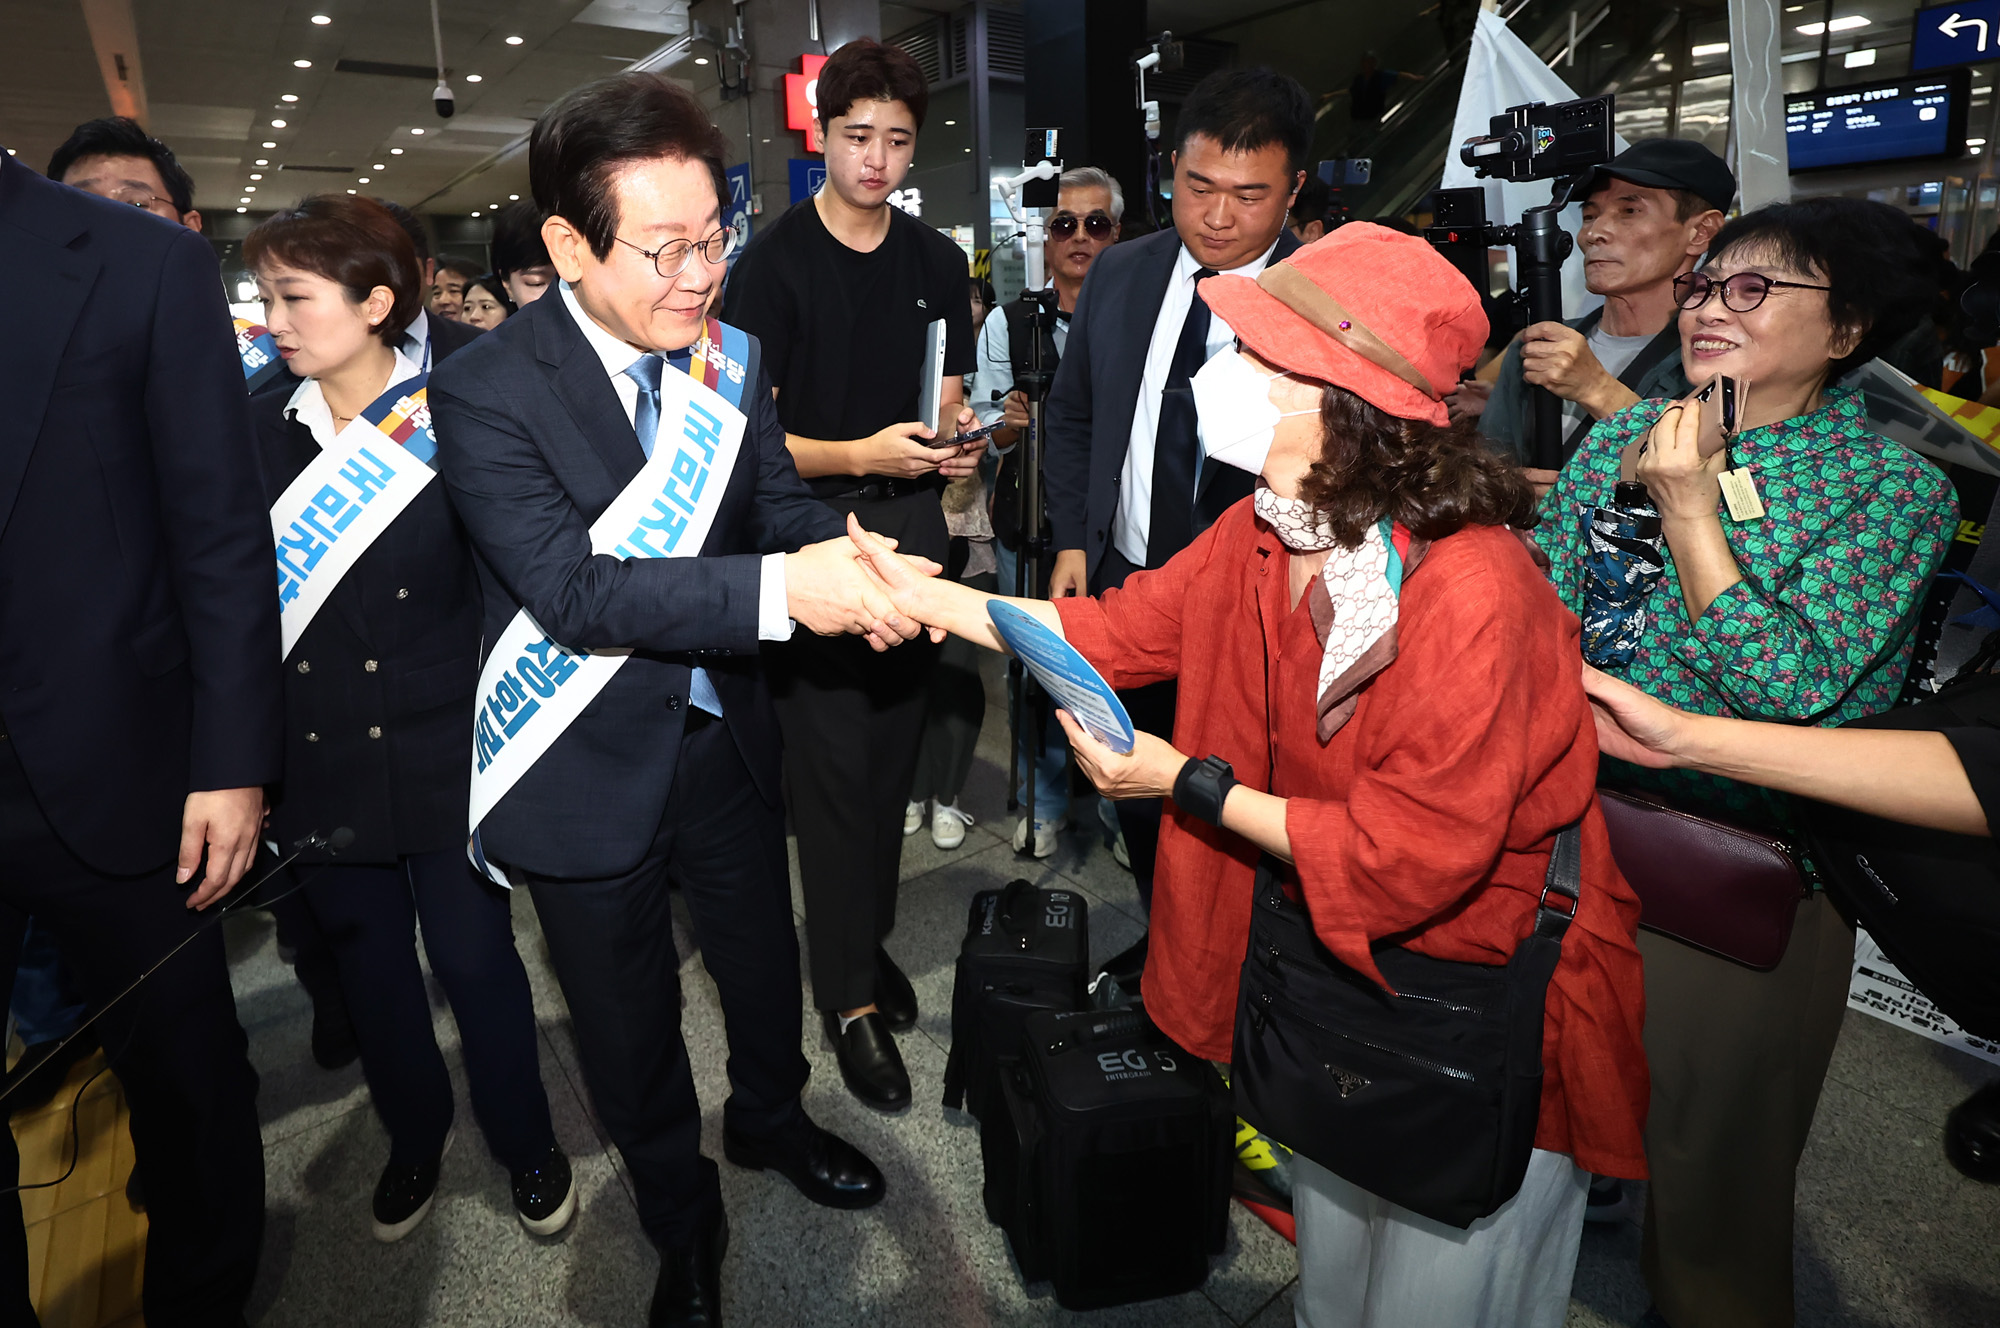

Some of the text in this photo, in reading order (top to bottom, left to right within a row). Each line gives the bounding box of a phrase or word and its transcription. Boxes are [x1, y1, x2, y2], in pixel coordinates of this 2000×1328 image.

[233, 327, 270, 369] 주당
[475, 400, 723, 775] 국민건 생회복
[1097, 1049, 1147, 1073] EG
